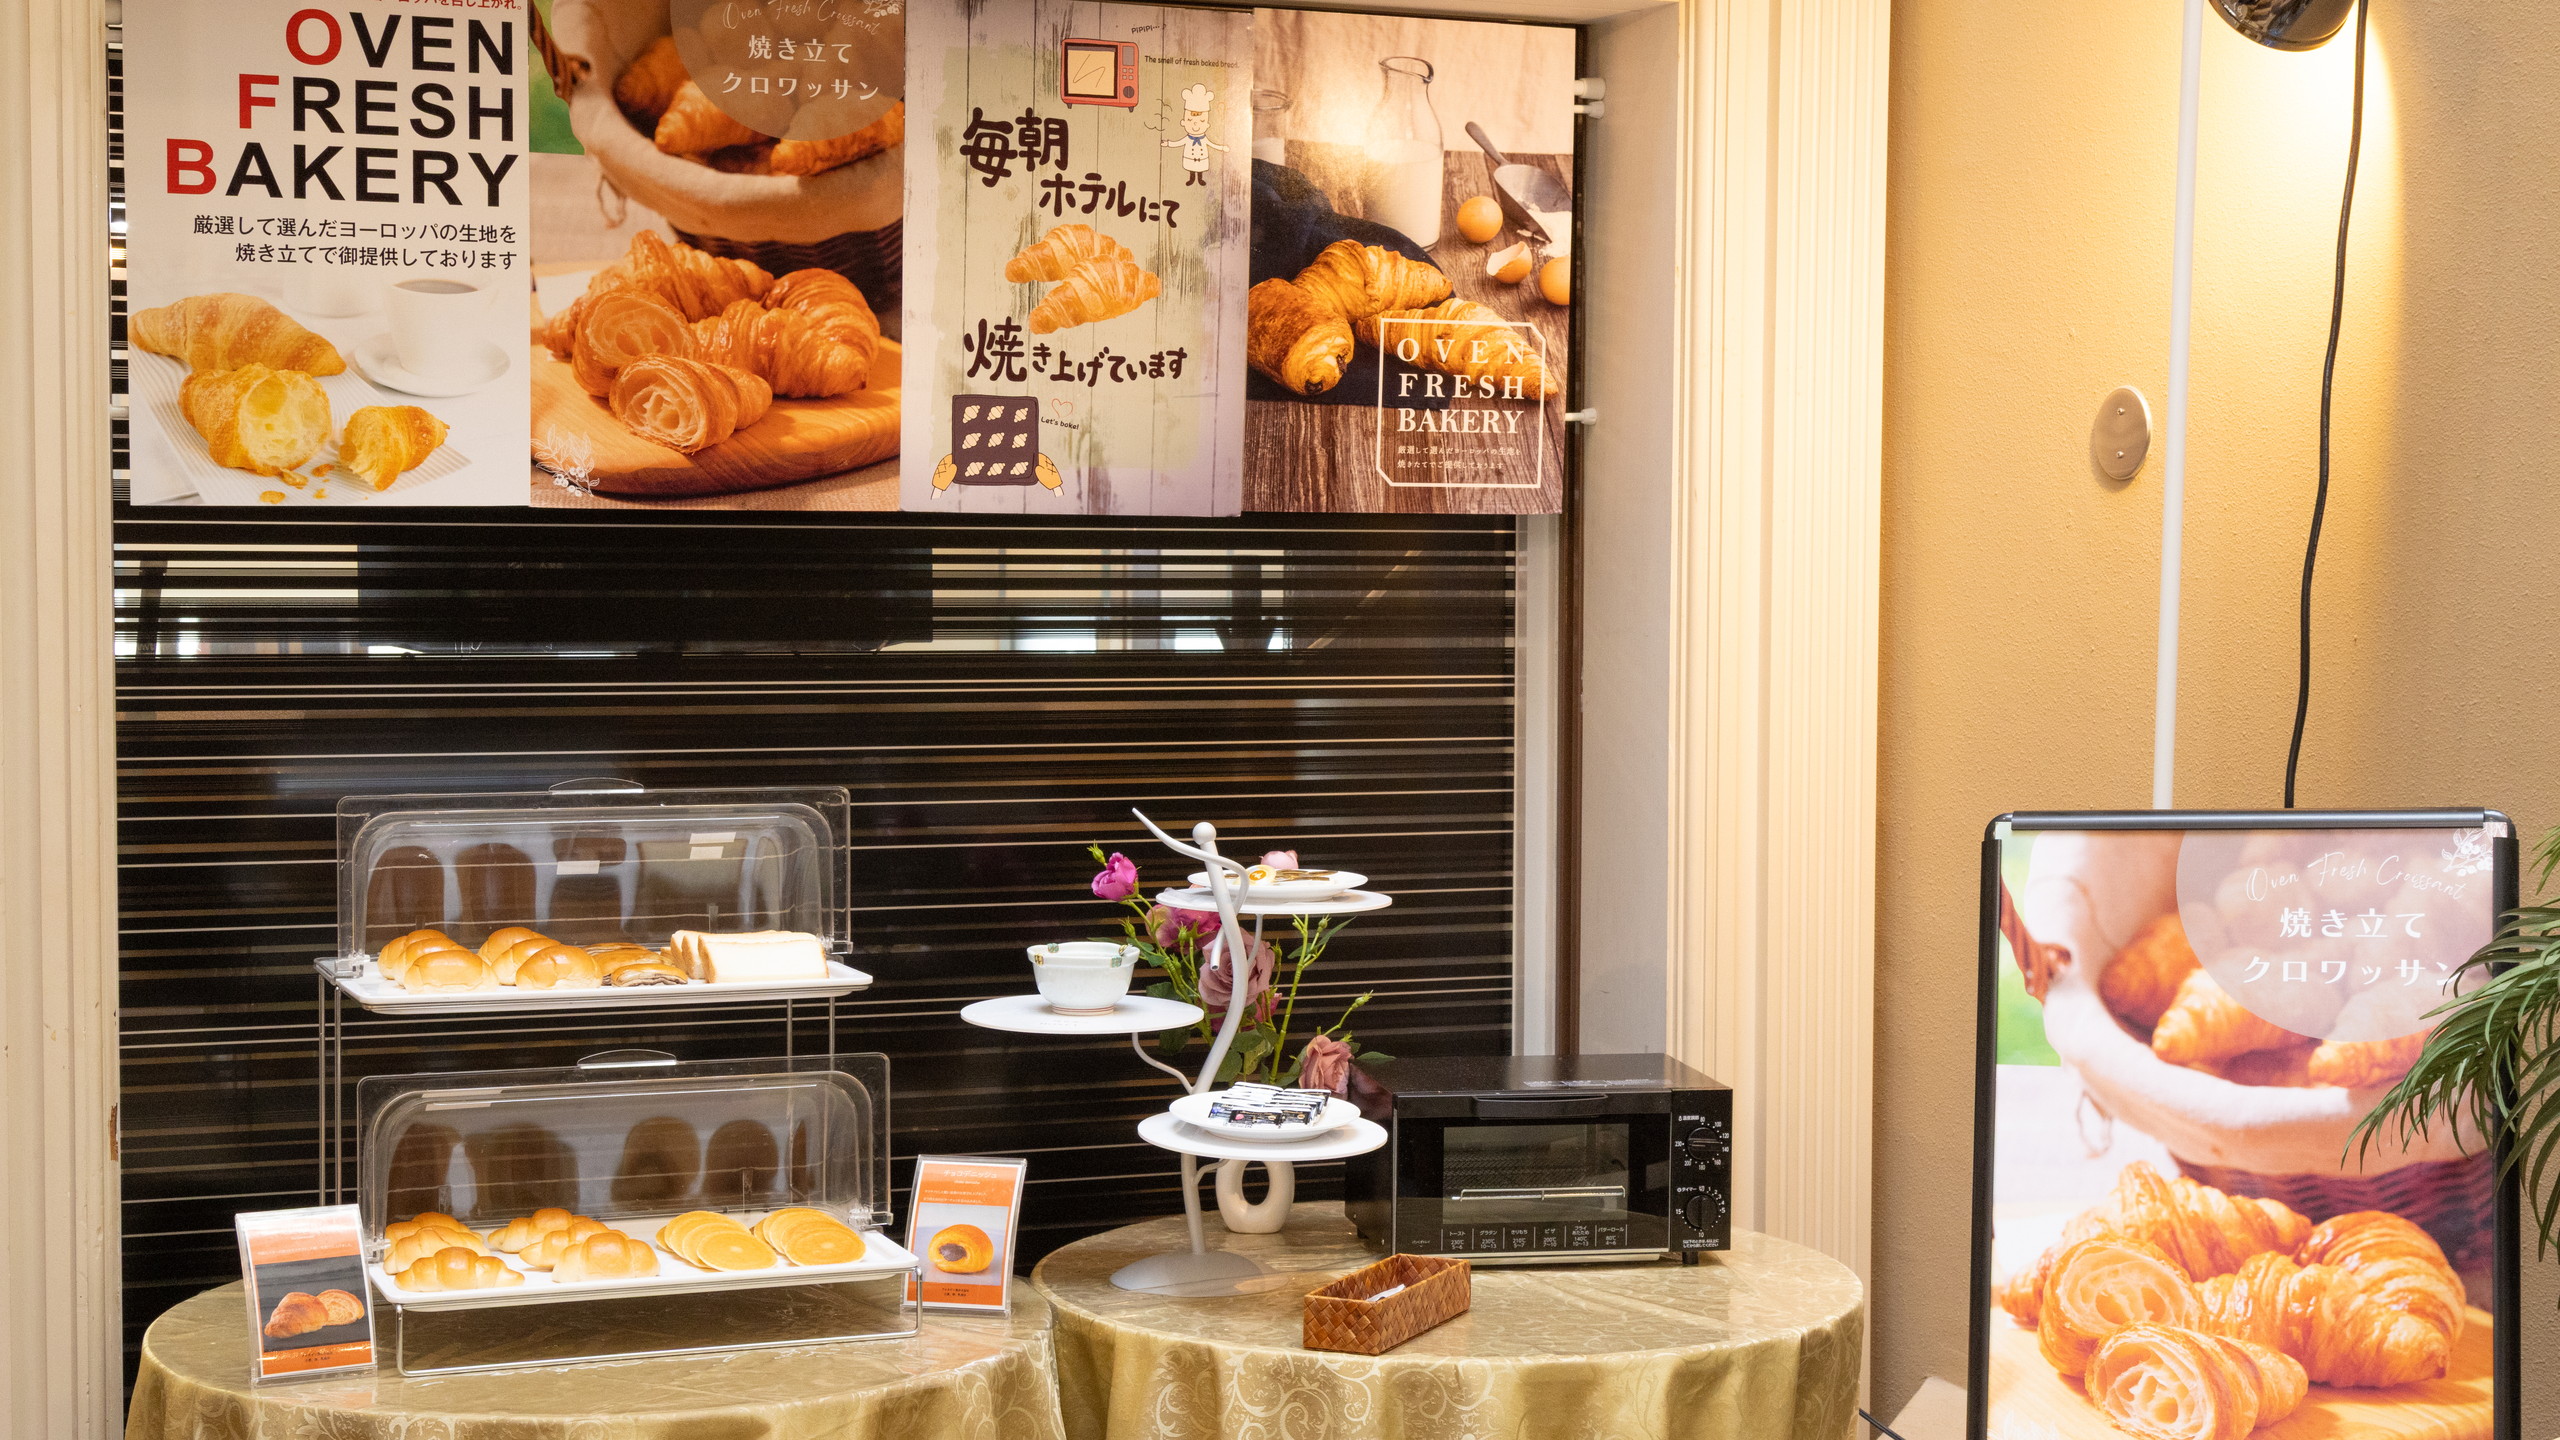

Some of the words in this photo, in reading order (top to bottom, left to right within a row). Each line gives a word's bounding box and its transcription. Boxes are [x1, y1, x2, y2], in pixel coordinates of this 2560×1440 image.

[723, 3, 761, 29] Oven
[286, 9, 513, 75] OVEN
[749, 35, 852, 63] 焼き立て
[1145, 55, 1156, 63] The
[1183, 58, 1199, 66] fresh
[1201, 59, 1219, 67] baked
[722, 72, 878, 100] クロワッサン
[239, 74, 513, 141] FRESH
[959, 107, 1069, 187] 毎朝
[166, 138, 518, 207] BAKERY
[1039, 173, 1180, 228] ホテルにて
[194, 215, 516, 243] 厳選して選んだヨーロッパの生地を
[236, 243, 517, 269] 焼き立てで御提供しております
[964, 316, 1187, 387] 焼き上げています
[1397, 337, 1525, 364] OVEN
[1398, 373, 1525, 399] FRESH
[1041, 416, 1058, 425] Let's
[1397, 408, 1524, 434] BAKERY
[2246, 868, 2299, 901] Oven
[2307, 852, 2367, 887] Fresh
[2376, 855, 2467, 899] Croissant
[2280, 907, 2425, 938] 焼き立て
[2243, 956, 2462, 986] クロワッサン
